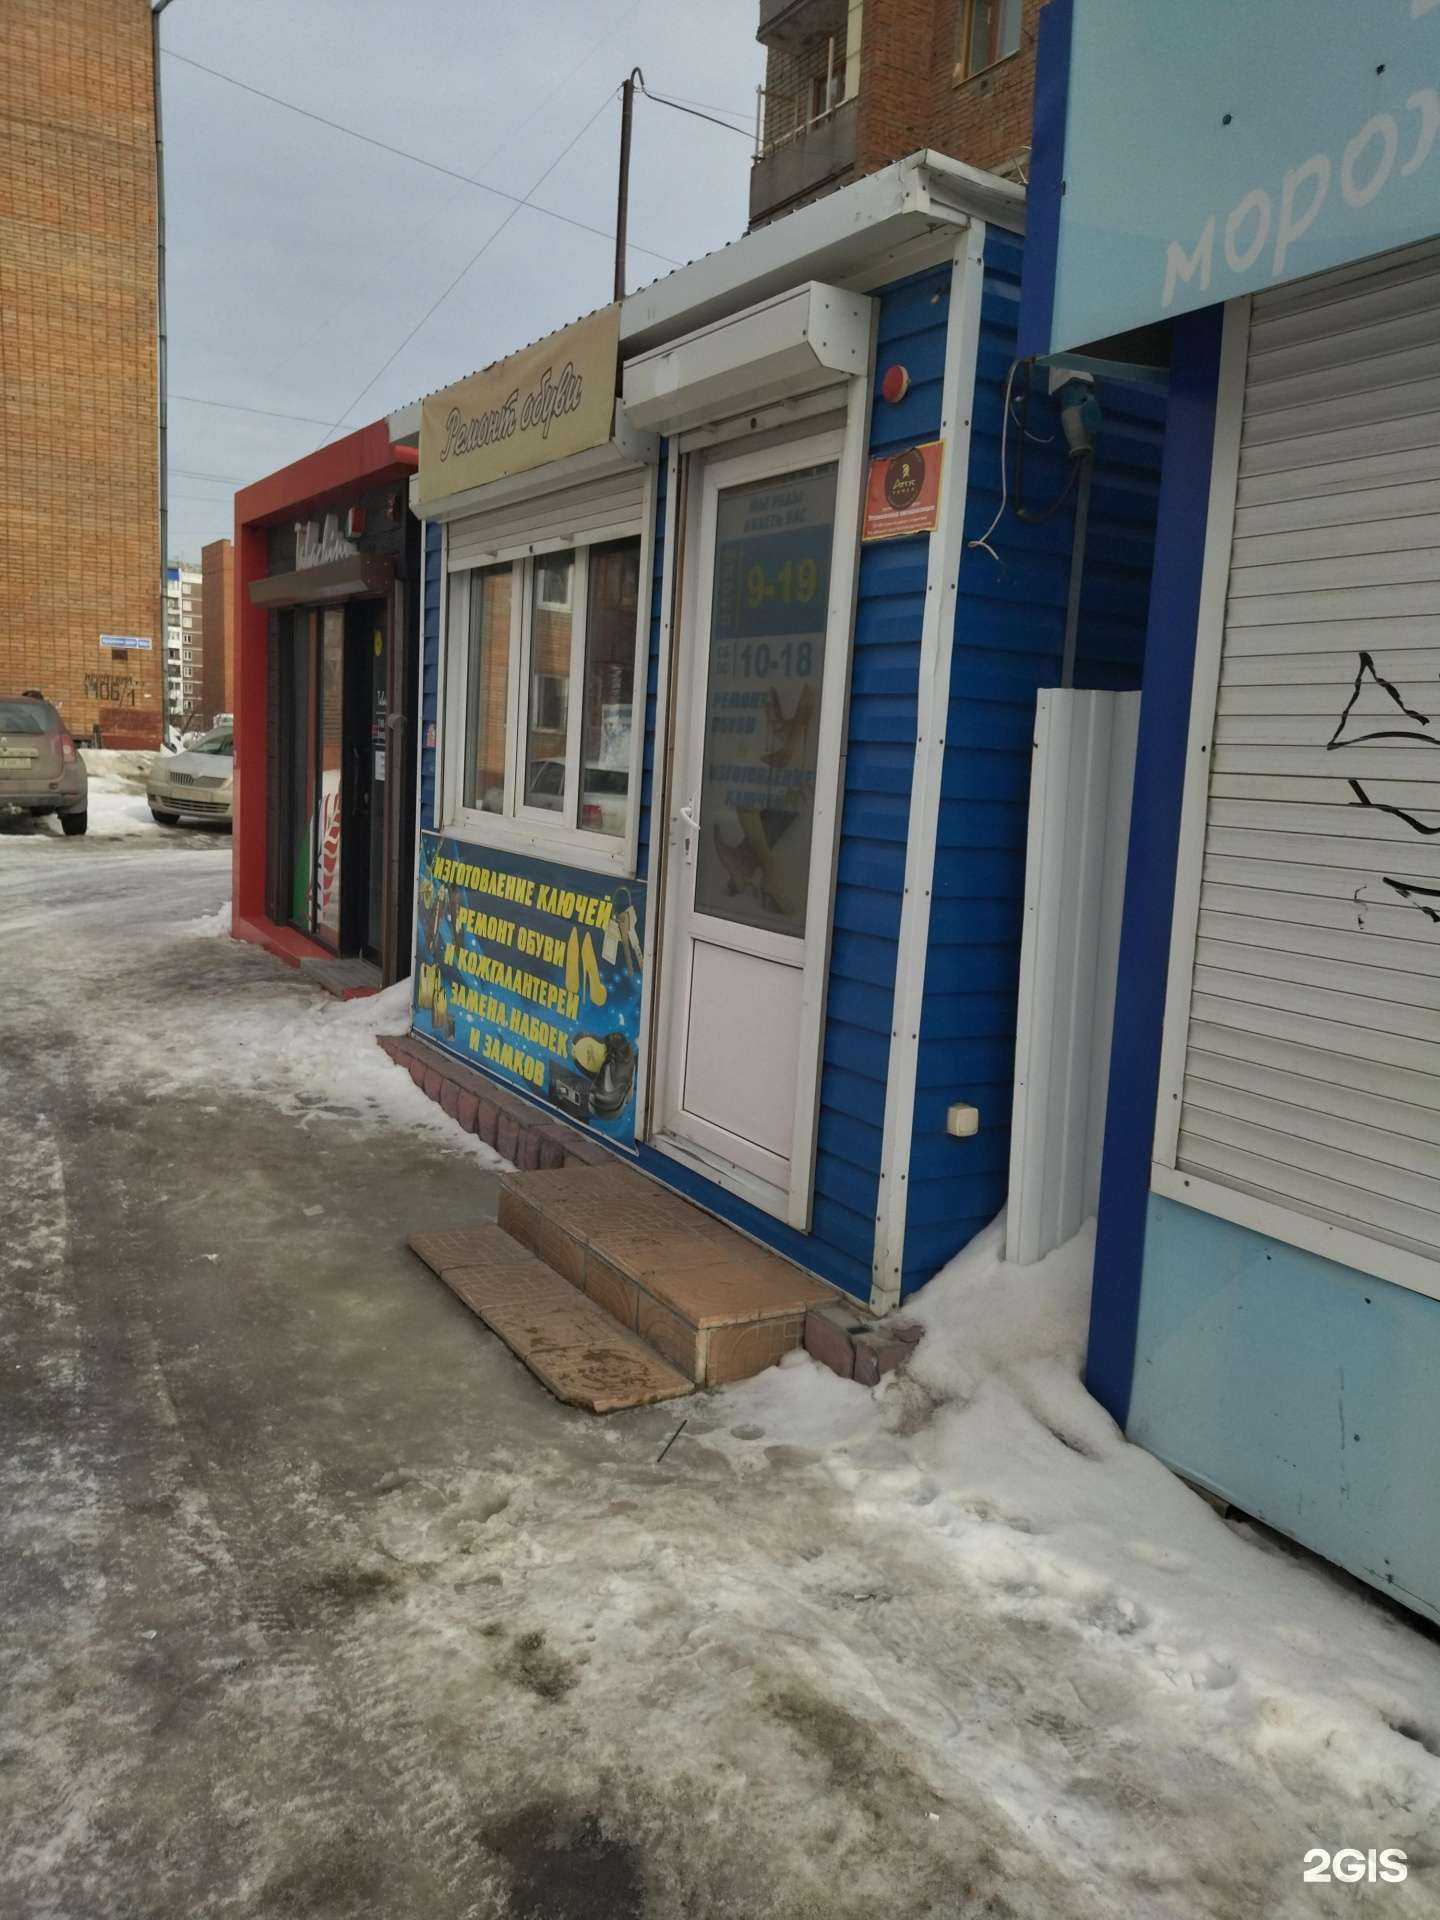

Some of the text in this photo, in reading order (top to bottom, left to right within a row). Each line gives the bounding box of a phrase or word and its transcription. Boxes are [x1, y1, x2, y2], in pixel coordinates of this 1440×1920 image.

[440, 361, 583, 462] Ремонт обуви
[746, 557, 818, 610] 9-19
[741, 641, 814, 679] 10-18
[433, 856, 613, 929] ИЗГОТОВЛЕНИЕ КЛЮЧЕЙ
[444, 943, 455, 967] И
[456, 906, 567, 968] РЕМОНТ ОБУВИ
[469, 1026, 545, 1087] И ЗАМКОВ
[510, 1007, 569, 1059] НАБОЕК
